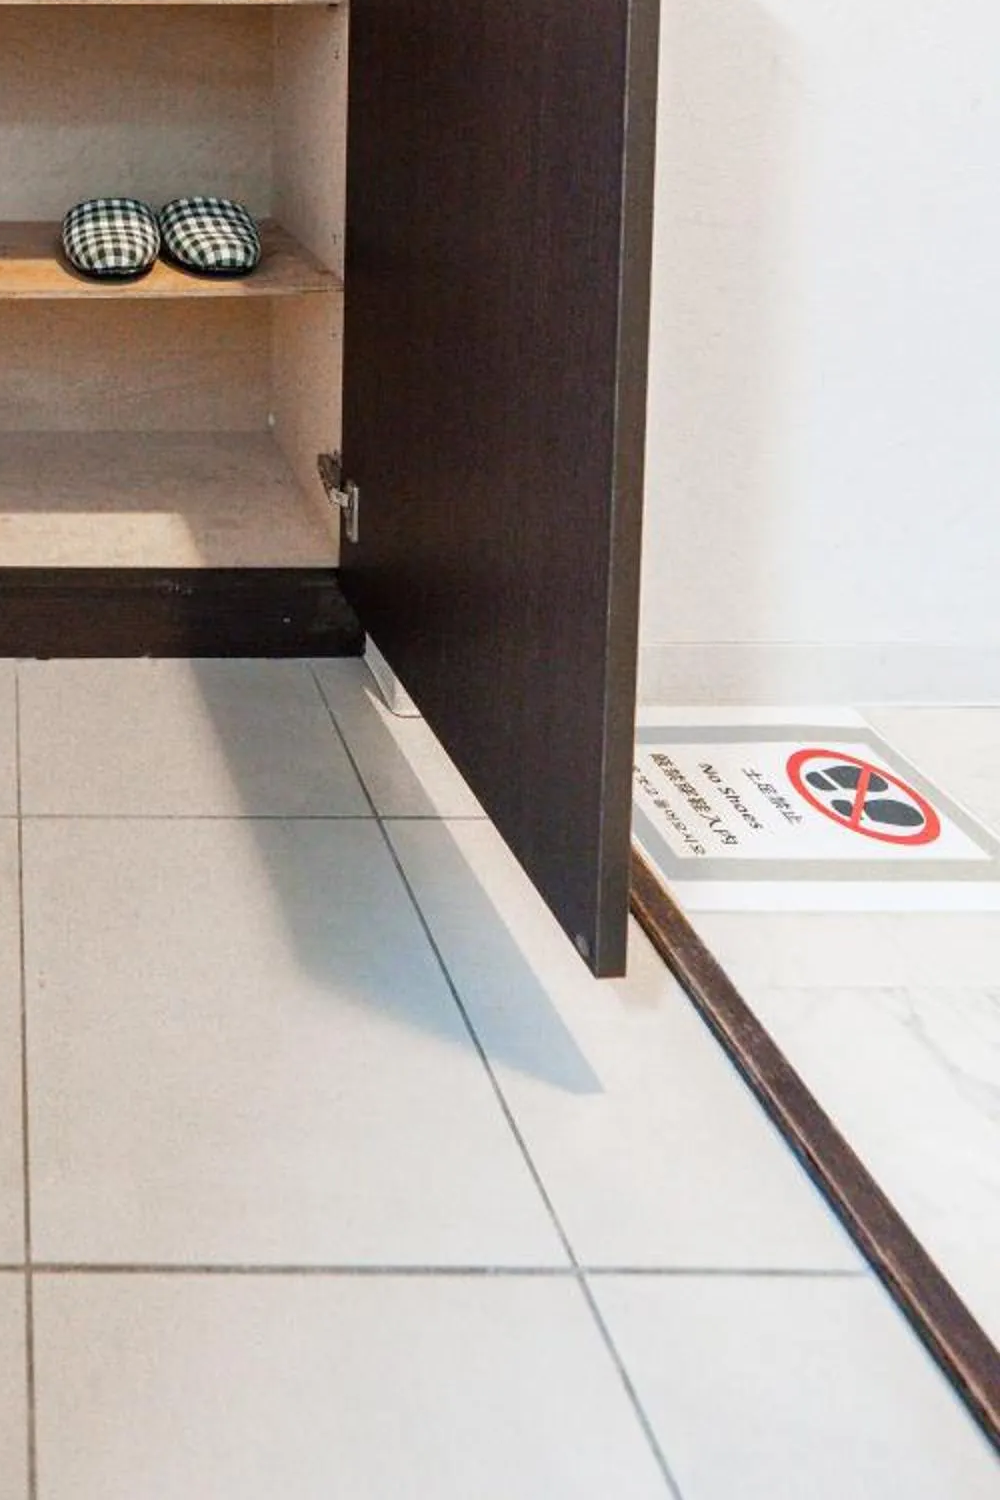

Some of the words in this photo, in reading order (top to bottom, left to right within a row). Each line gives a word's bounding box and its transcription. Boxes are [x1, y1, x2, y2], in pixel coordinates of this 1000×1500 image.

[698, 763, 721, 783] No
[717, 787, 764, 829] Shoes
[741, 767, 802, 825] 土足禁止
